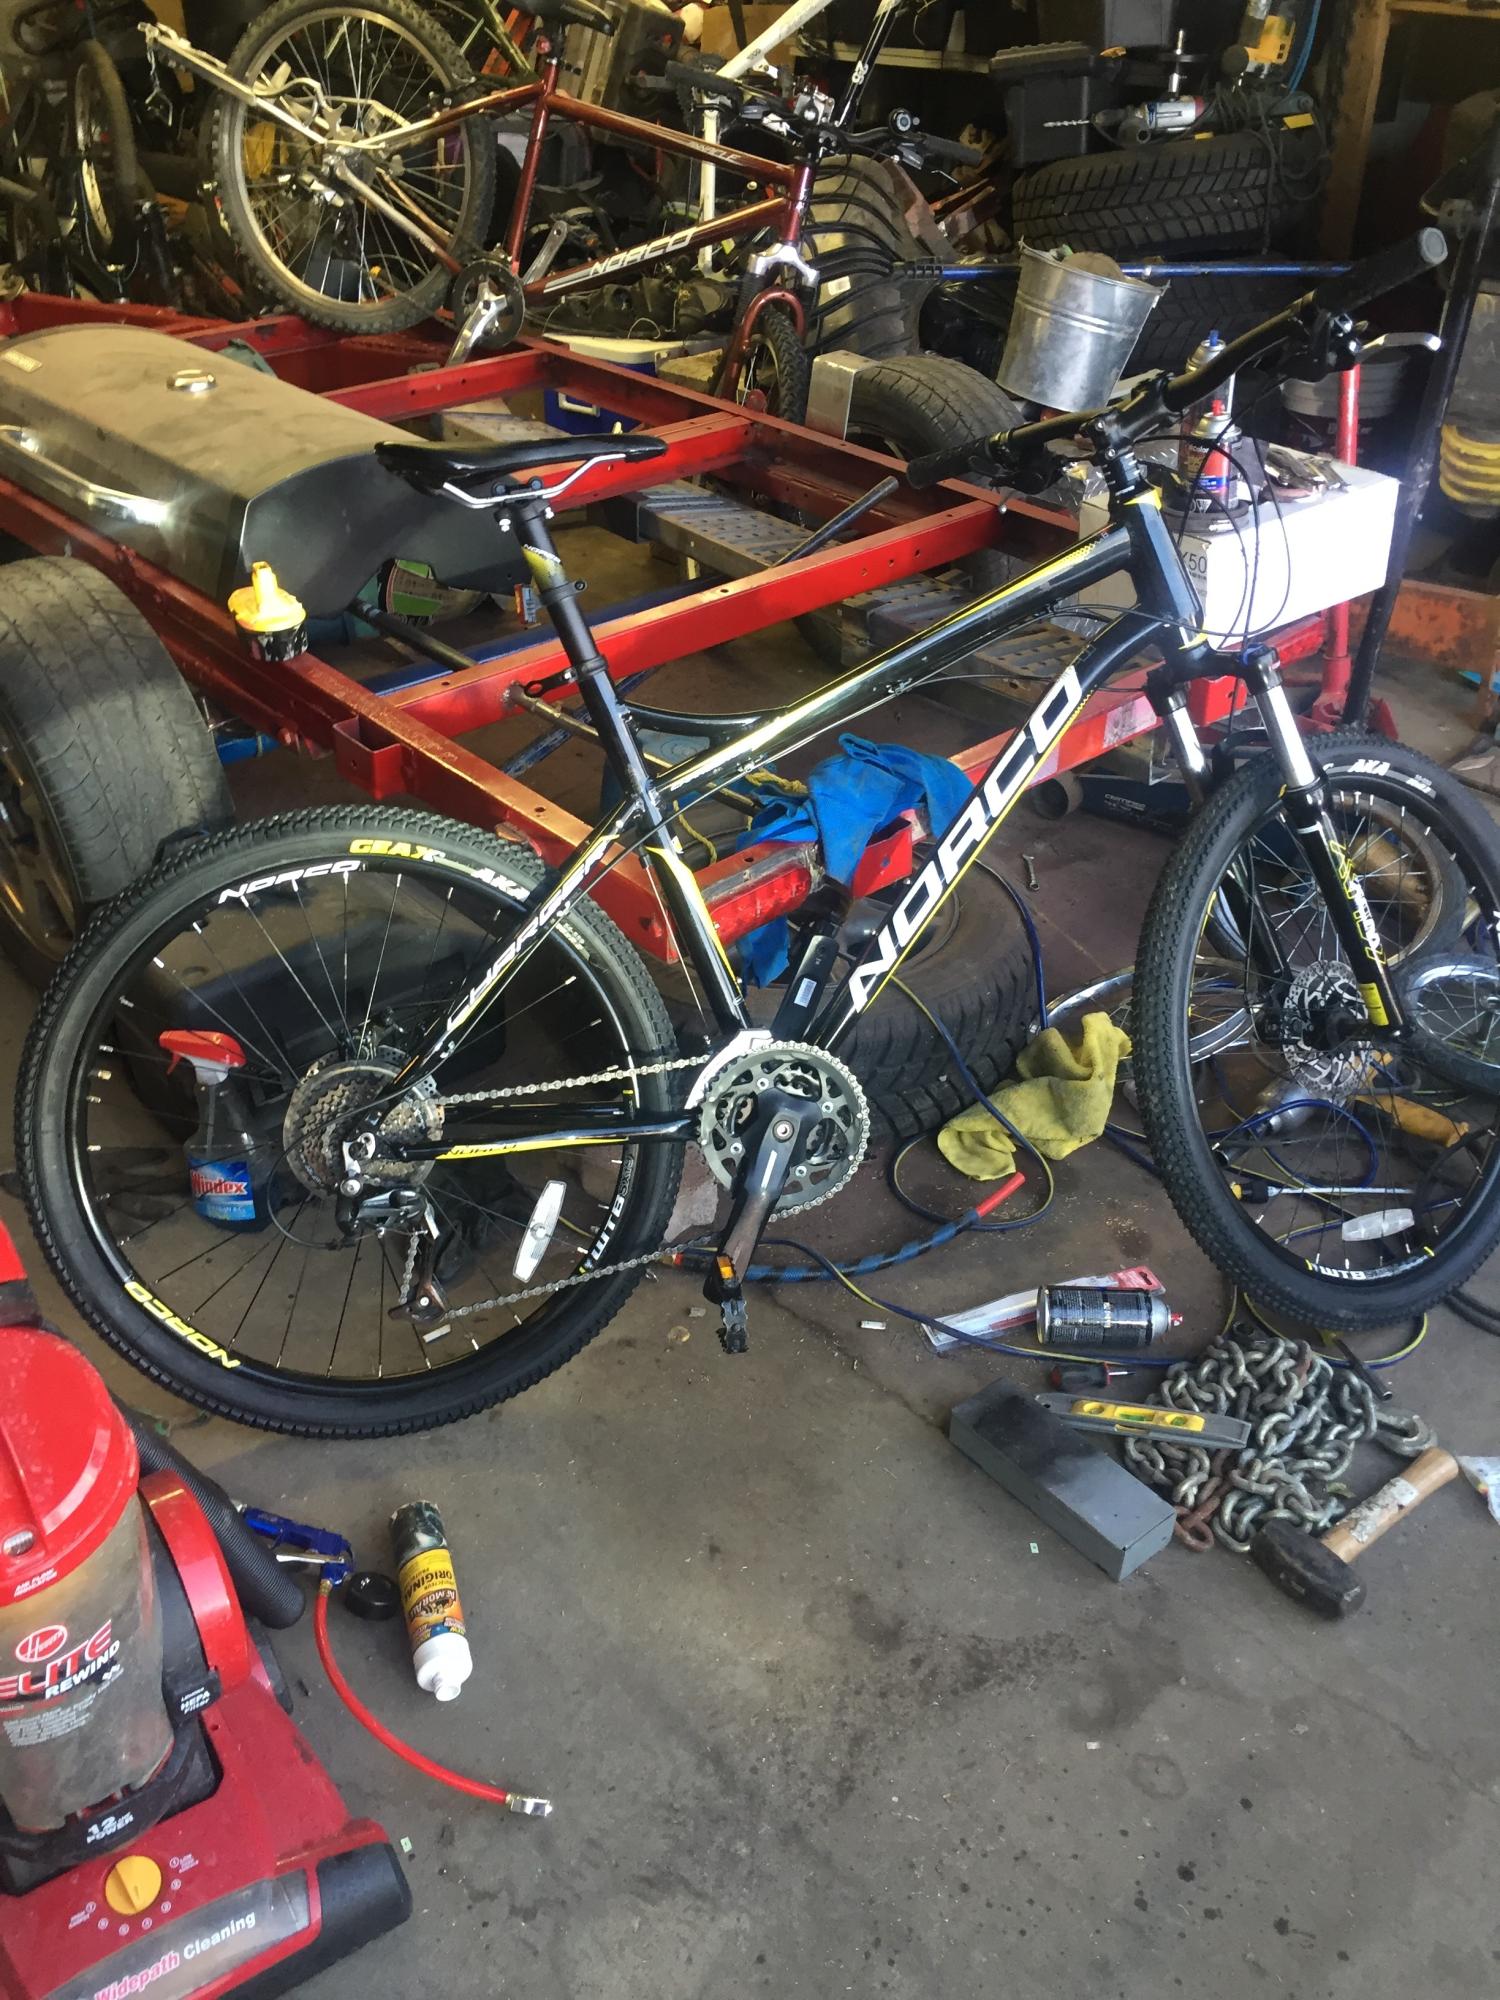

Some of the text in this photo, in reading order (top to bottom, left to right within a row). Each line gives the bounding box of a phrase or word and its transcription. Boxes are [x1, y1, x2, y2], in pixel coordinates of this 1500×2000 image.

[591, 226, 695, 277] NORCO
[350, 839, 437, 861] GEAX
[848, 665, 1083, 1014] NORCO
[217, 859, 362, 905] NORCO
[446, 832, 614, 1033] CHARGER
[190, 1168, 244, 1195] Windex
[590, 1193, 625, 1260] WTB
[1319, 1264, 1367, 1281] WTB
[123, 1280, 242, 1370] NORCO
[0, 1618, 112, 1700] ELITE
[45, 1639, 121, 1700] REWIND
[94, 1911, 256, 2000] Widepath Cleaning
